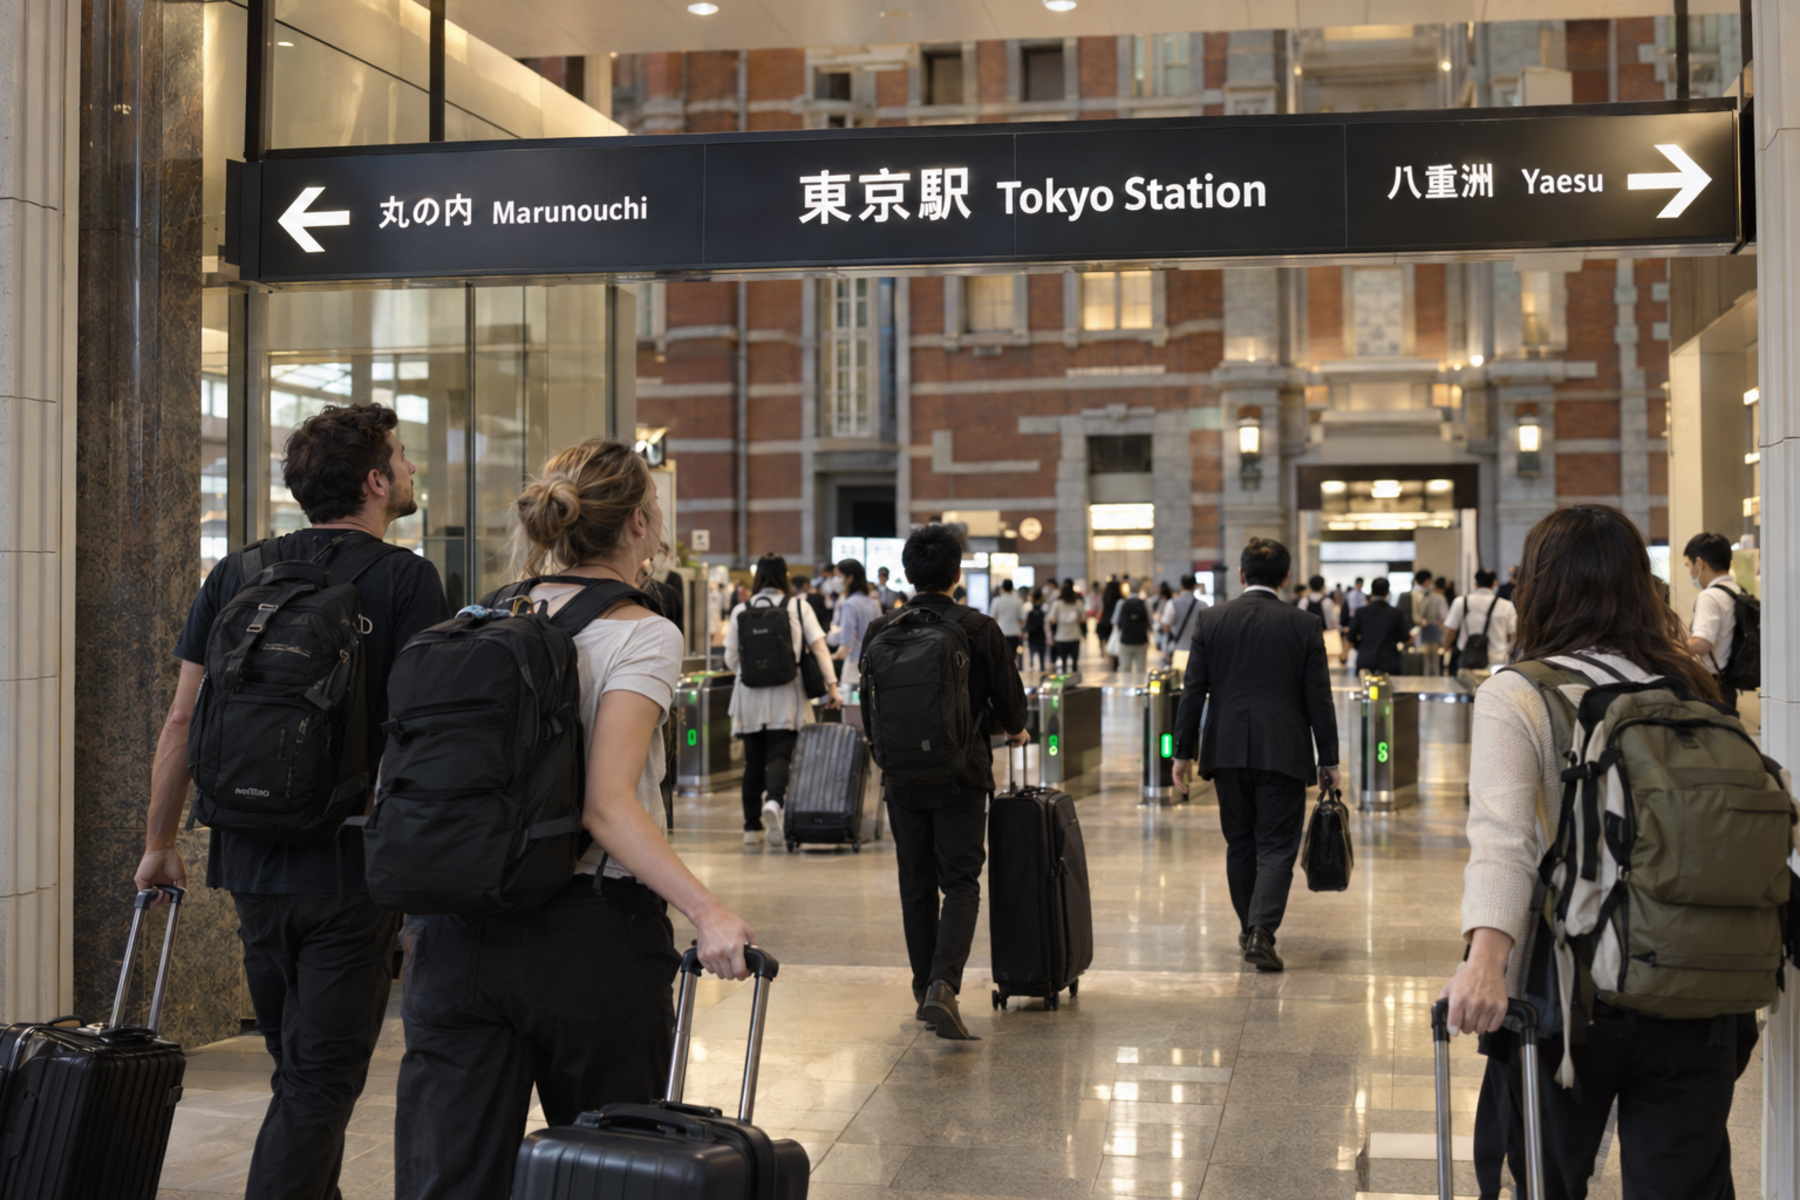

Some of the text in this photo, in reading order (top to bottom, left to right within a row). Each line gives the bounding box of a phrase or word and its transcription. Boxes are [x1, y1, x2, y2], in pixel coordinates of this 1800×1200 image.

[798, 167, 1267, 225] 東京駅 Tokyo Station
[1387, 163, 1604, 199] 八重洲 Yaesu
[378, 193, 648, 229] 丸の内 Marunouchi
